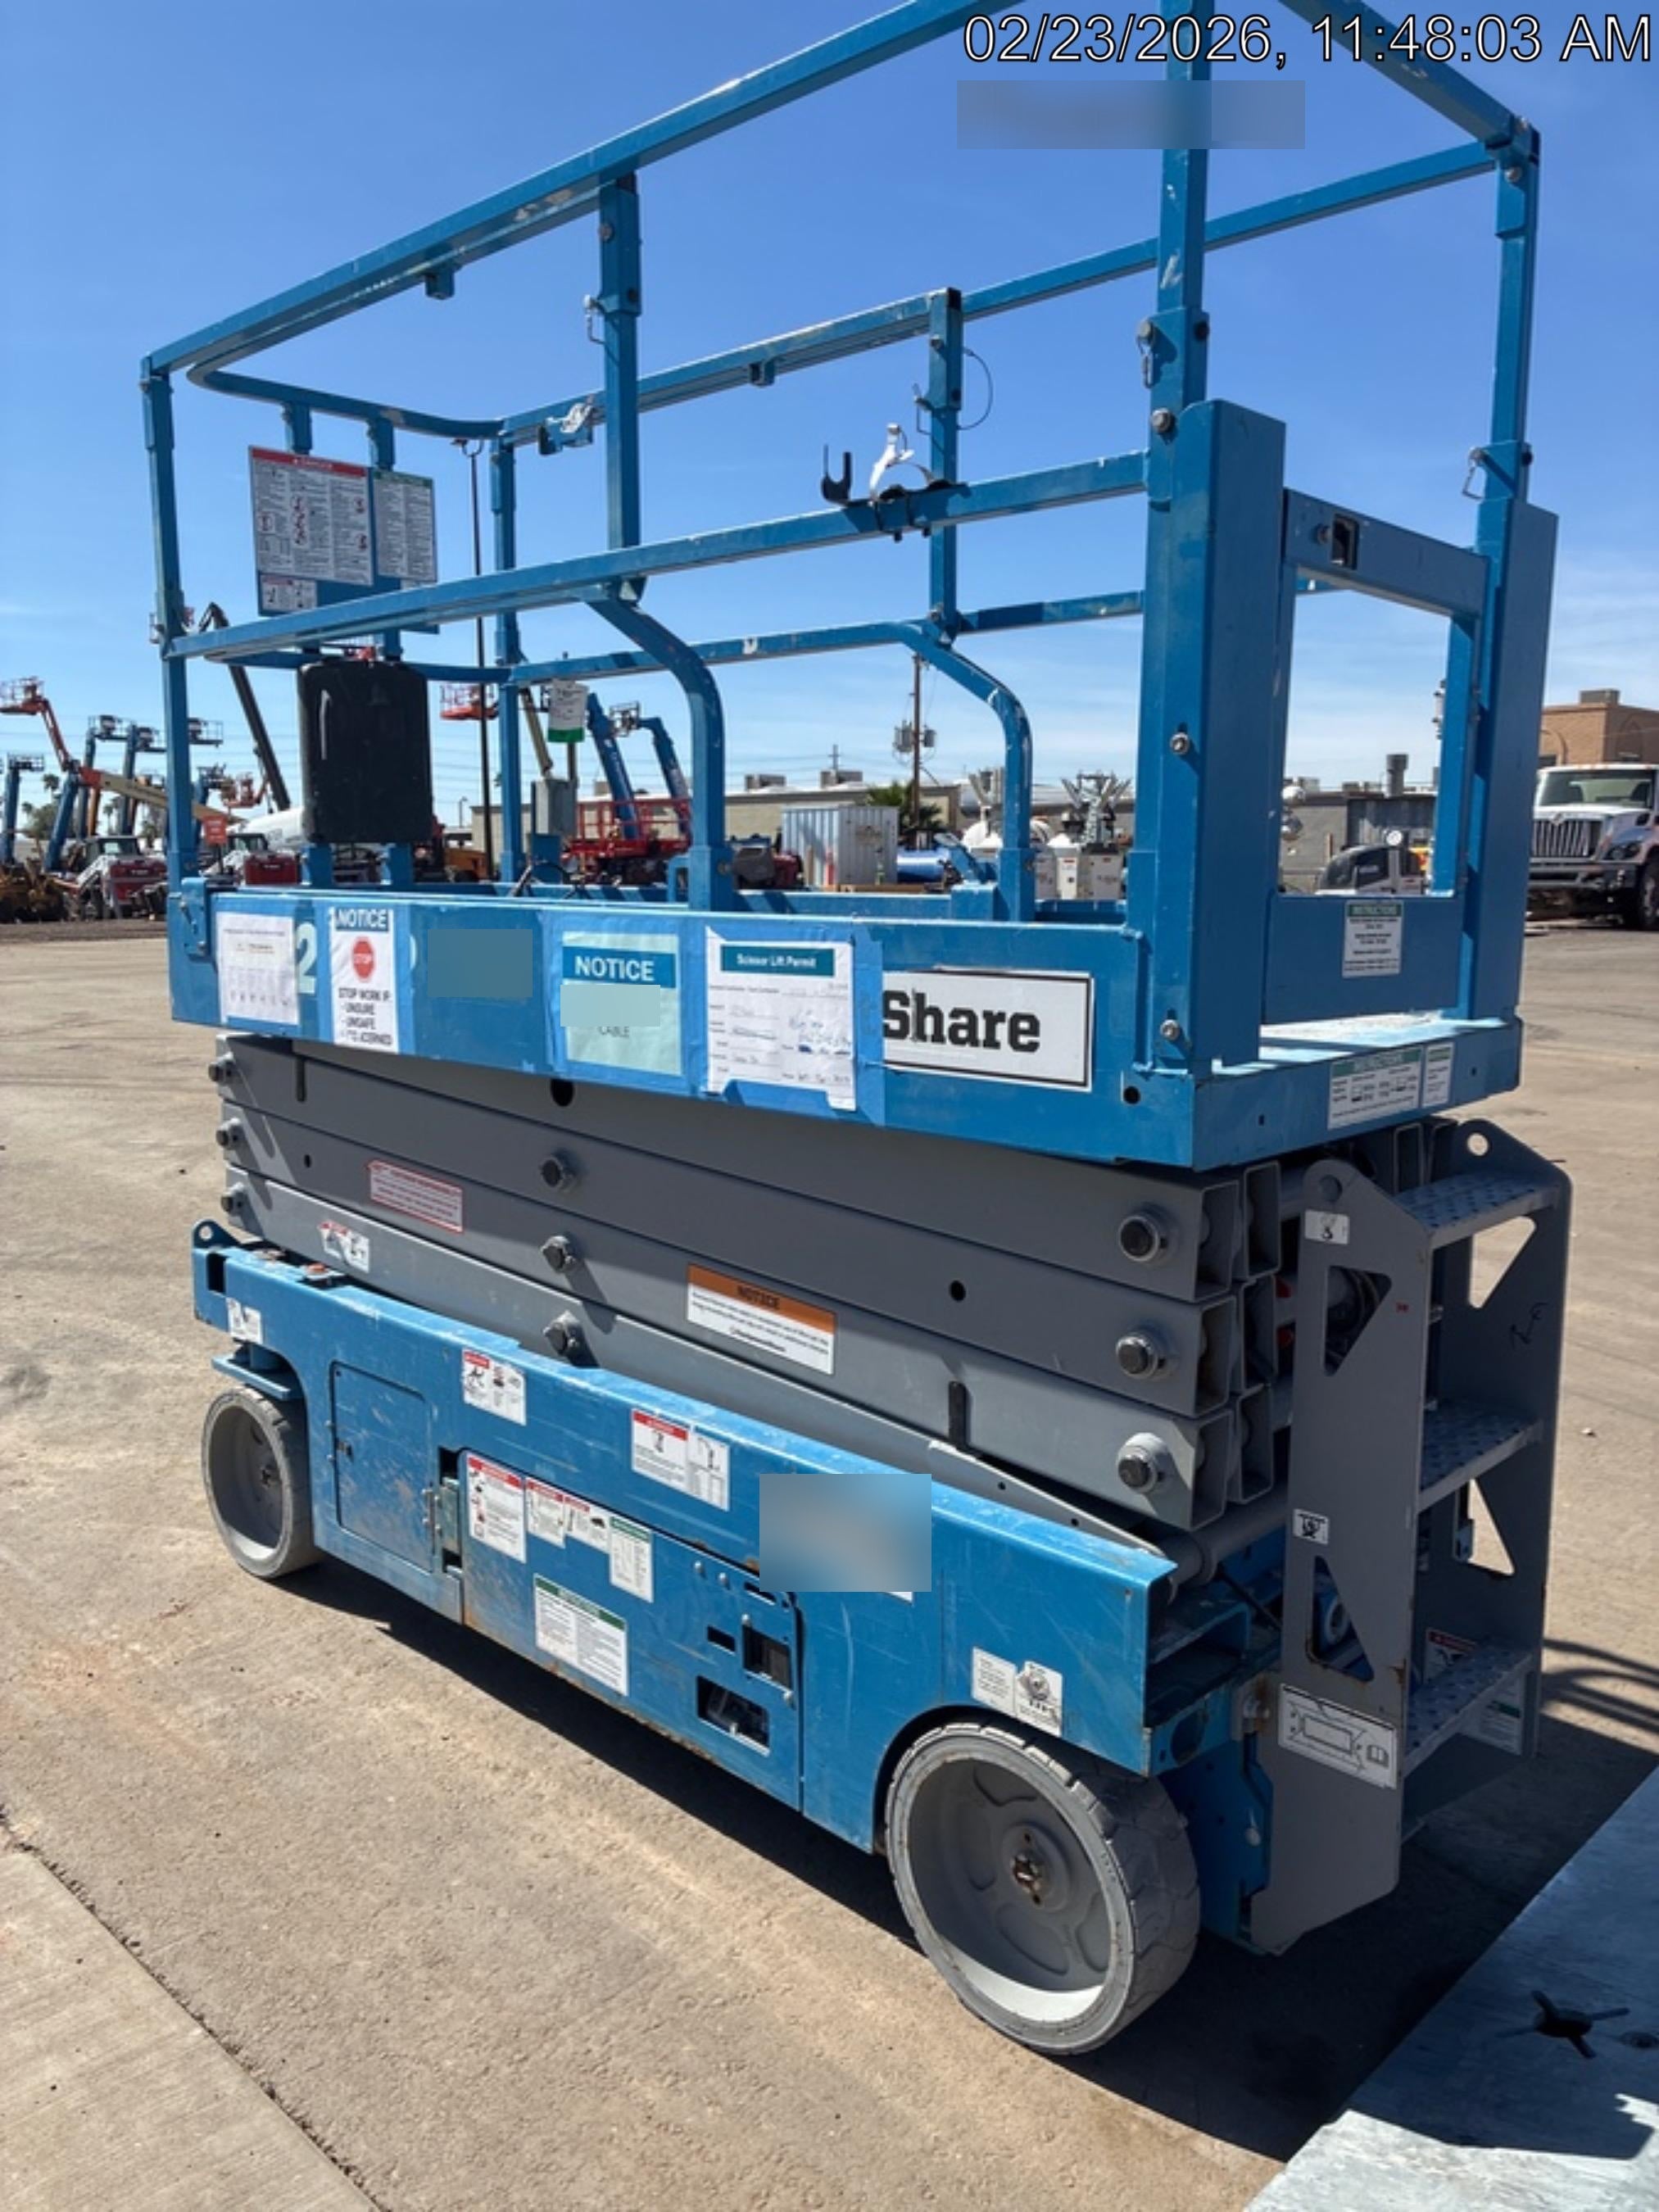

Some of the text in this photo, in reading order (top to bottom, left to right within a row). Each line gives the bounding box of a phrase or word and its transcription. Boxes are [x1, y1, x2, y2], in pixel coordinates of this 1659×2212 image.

[338, 908, 388, 928] NOTICE
[295, 922, 318, 994] 2
[574, 954, 655, 982] NOTICE
[338, 987, 357, 999] STOP
[883, 988, 1041, 1053] Share
[737, 1284, 781, 1310] NOTICE
